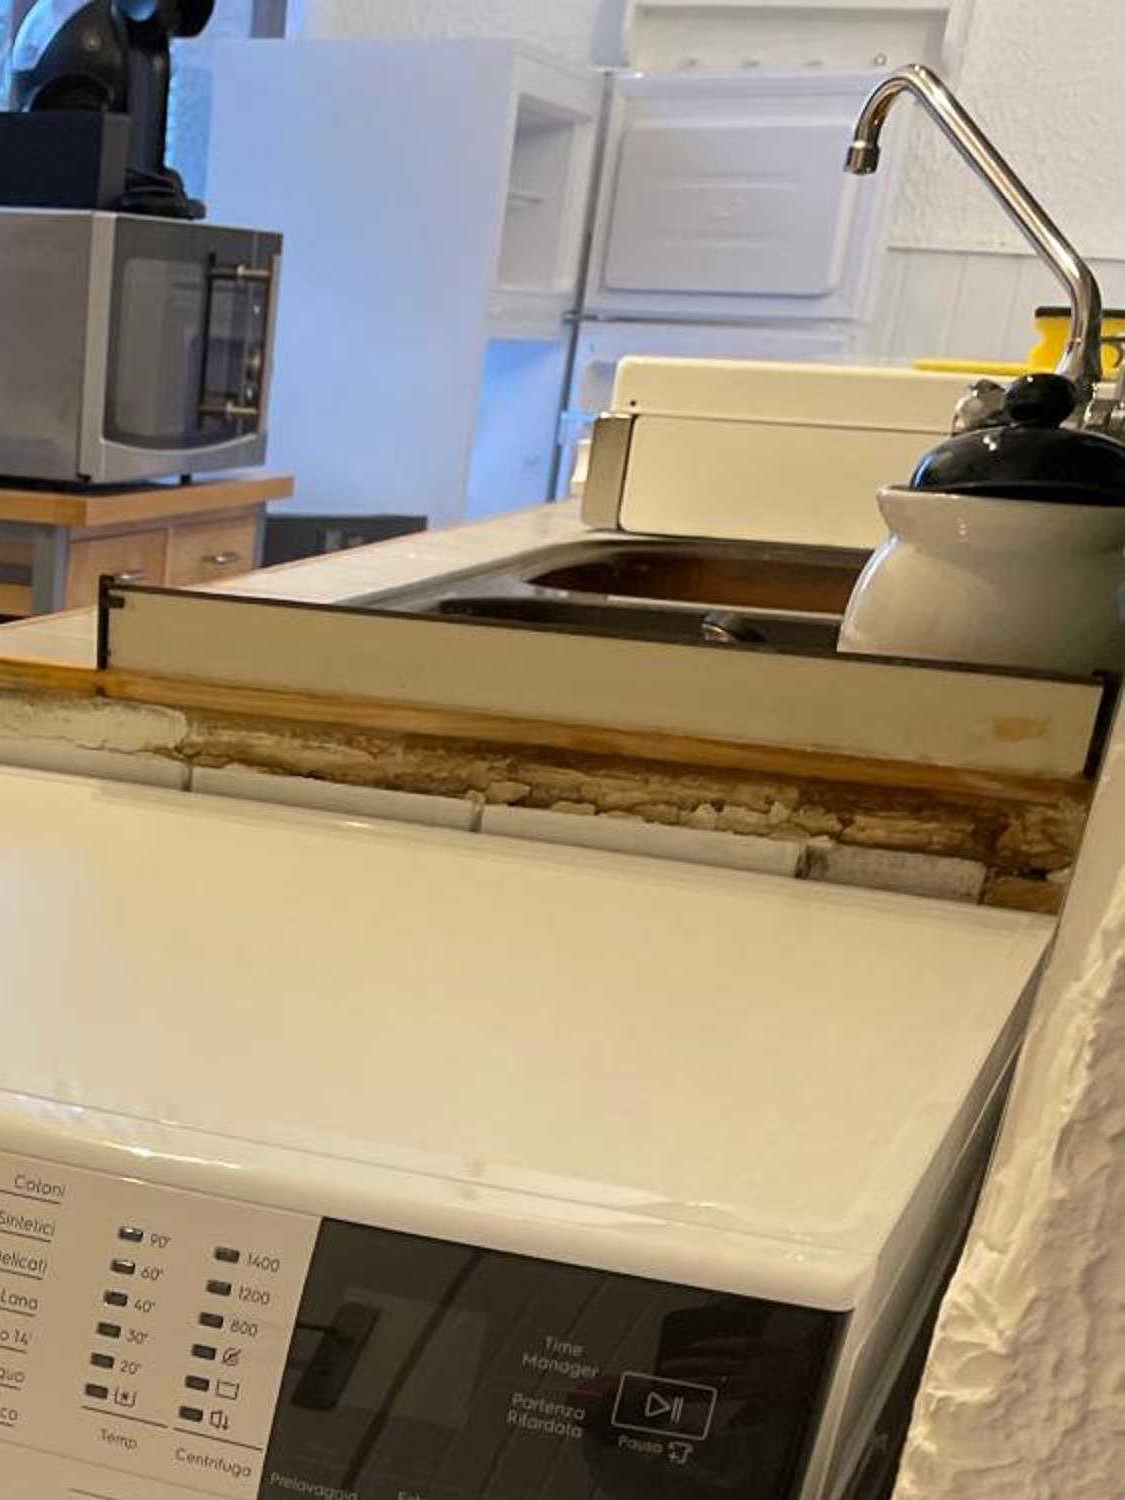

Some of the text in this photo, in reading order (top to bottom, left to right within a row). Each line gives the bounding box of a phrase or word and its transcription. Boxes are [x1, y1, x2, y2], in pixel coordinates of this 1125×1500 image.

[247, 1253, 280, 1273] 1400
[0, 1287, 39, 1311] Lana
[238, 1286, 270, 1305] 1200
[230, 1319, 258, 1338] 800
[546, 1335, 584, 1356] Time
[522, 1353, 600, 1379] Manager
[511, 1392, 586, 1421] Partenza
[618, 1435, 664, 1455] Pausa
[175, 1448, 252, 1478] Centrifuga
